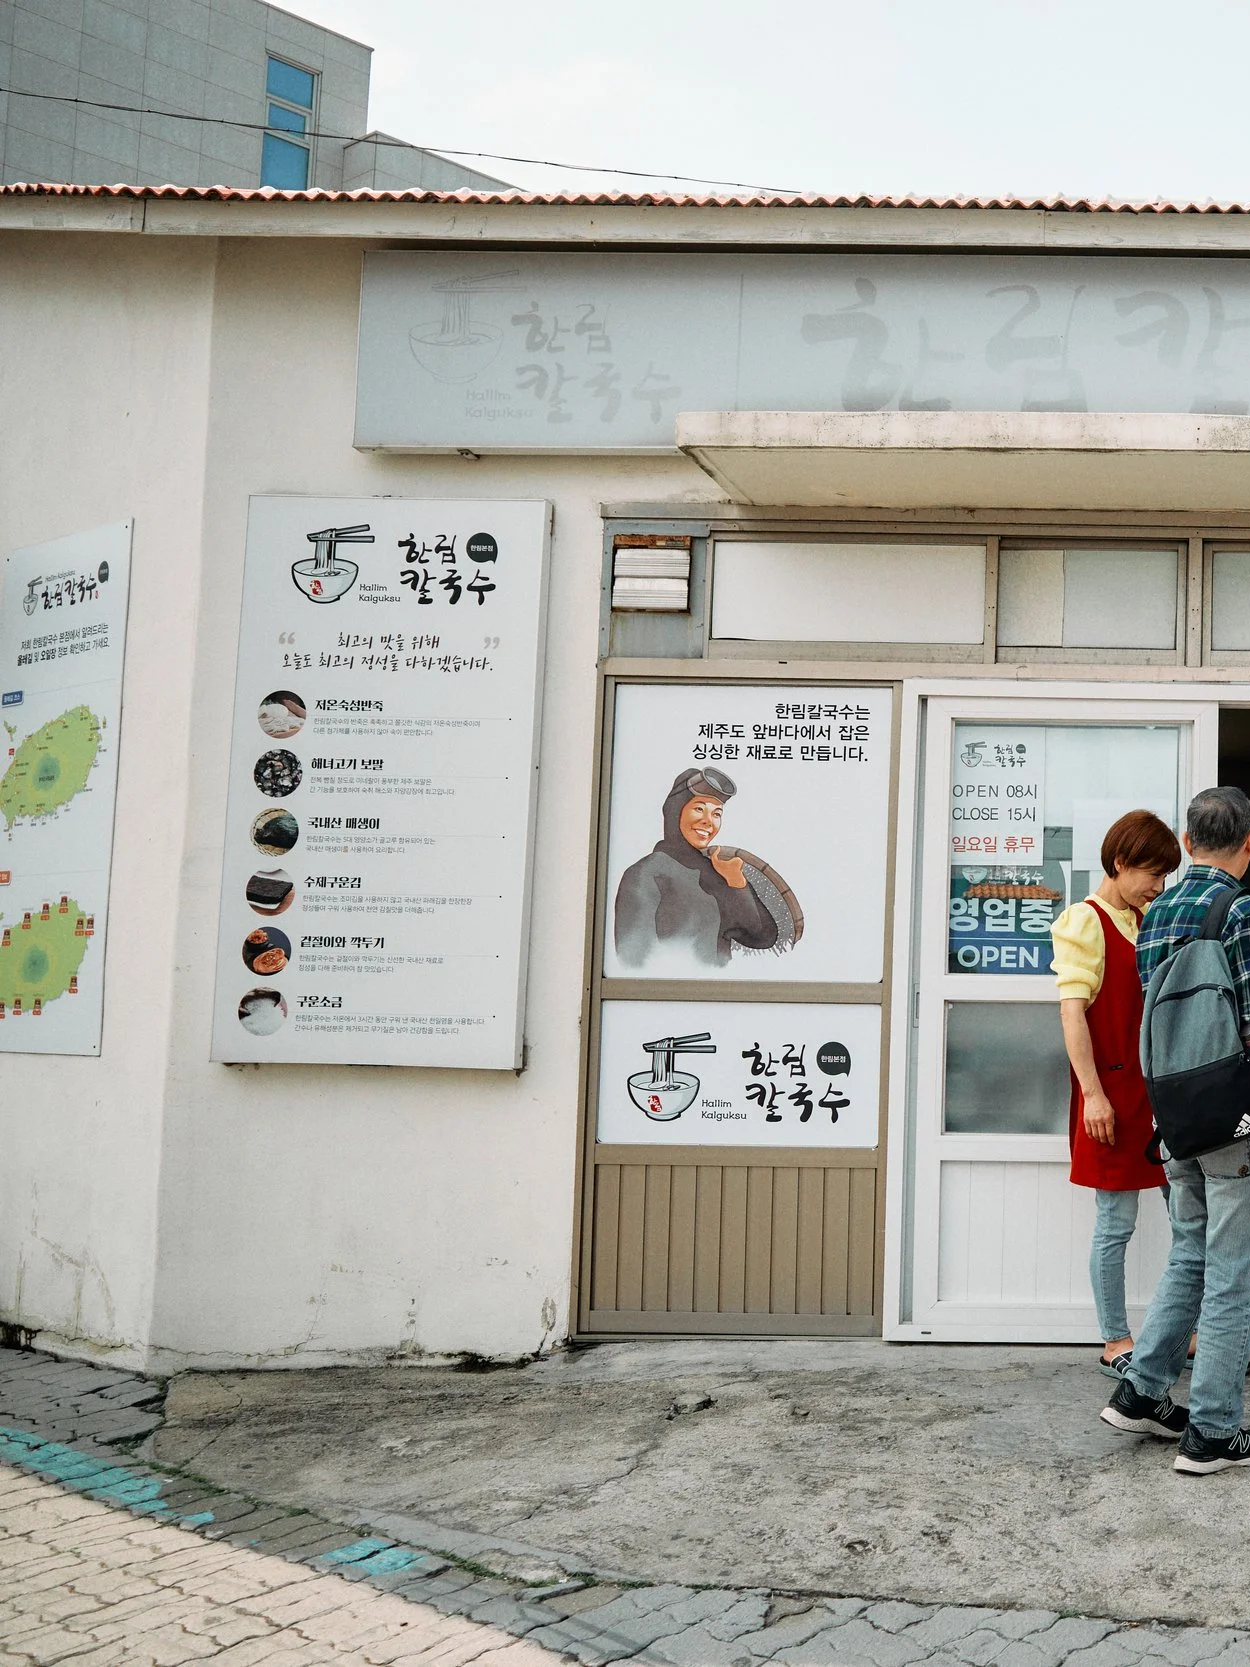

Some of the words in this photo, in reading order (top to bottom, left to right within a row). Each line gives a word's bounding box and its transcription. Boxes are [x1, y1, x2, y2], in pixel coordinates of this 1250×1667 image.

[510, 301, 613, 354] 한림
[465, 389, 512, 402] Hallim
[514, 361, 683, 424] 칼국수
[464, 406, 535, 421] Kalguksu
[398, 533, 457, 565] 한림
[41, 572, 97, 610] 한림칼국수
[359, 583, 388, 592] Hallim
[400, 568, 497, 606] 칼국수
[358, 593, 400, 605] Kalguksu
[33, 633, 58, 649] 한림칼국수
[337, 632, 373, 649] 최고의
[380, 634, 405, 651] 맛을
[411, 634, 440, 650] 위해
[282, 653, 312, 670] 오늘도
[318, 652, 354, 670] 최고의
[361, 654, 399, 672] 정성을
[405, 655, 494, 673] 다하겠습니다.
[315, 699, 384, 712] 저온숙성반죽
[775, 703, 871, 720] 한림칼국수는
[698, 723, 746, 740] 제주도
[752, 724, 832, 741] 앞바다에서
[838, 725, 870, 741] 잡은
[692, 744, 740, 761] 싱싱한
[746, 745, 794, 761] 재료로
[800, 745, 869, 762] 만듭니다.
[994, 744, 1014, 755] 한림
[311, 758, 357, 770] 해녀고기
[361, 758, 384, 771] 보말
[995, 755, 1027, 768] 칼국수
[952, 785, 999, 798] OPEN
[1006, 784, 1038, 800] 08시
[952, 807, 999, 821] CLOSE
[1007, 807, 1036, 822] 15시
[307, 817, 342, 829] 국내산
[345, 817, 380, 830] 매생이
[952, 836, 998, 853] 일요일
[1003, 835, 1035, 853] 휴무
[304, 876, 361, 889] 수제구운김
[949, 898, 1053, 933] 영업중
[300, 936, 347, 948] 겉절이와
[350, 937, 385, 949] 깍두기
[957, 945, 1039, 968] OPEN
[296, 996, 343, 1008] 구운소금
[741, 1042, 806, 1078] 한림
[820, 1055, 847, 1064] 한림본점
[701, 1099, 732, 1108] Hallim
[745, 1082, 851, 1123] 칼국수
[701, 1110, 747, 1122] Kalguksu
